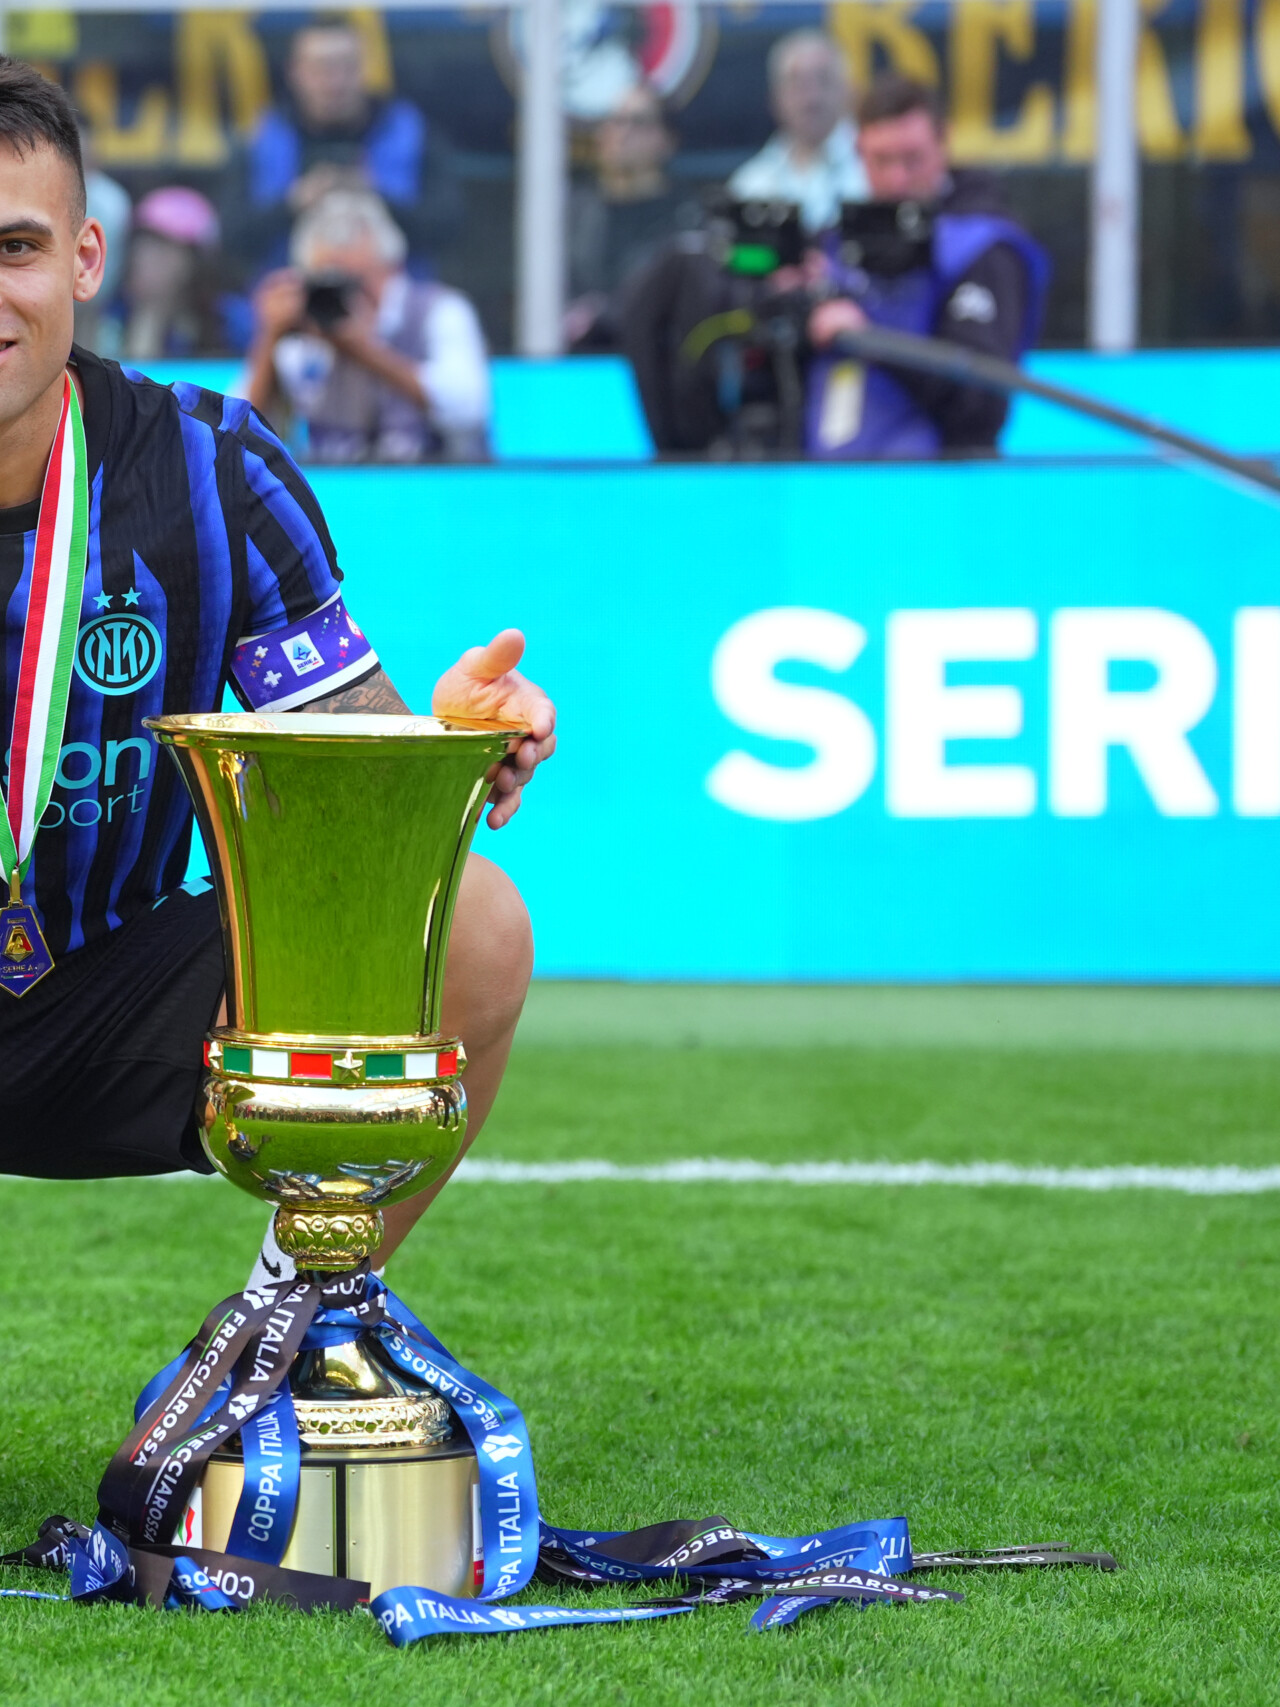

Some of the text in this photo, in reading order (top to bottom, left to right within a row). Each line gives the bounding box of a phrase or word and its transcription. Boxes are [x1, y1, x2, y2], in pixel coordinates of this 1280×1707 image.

[134, 1312, 246, 1466] FRECCIAROSSA
[249, 1308, 296, 1382] ITALIA
[380, 1328, 501, 1431] RECCIAROSSA
[144, 1419, 229, 1543] FRECCIAROSSA
[248, 1411, 283, 1542] COPPA ITALIA
[497, 1471, 522, 1554] ITALIA
[416, 1598, 491, 1626] ITALIA
